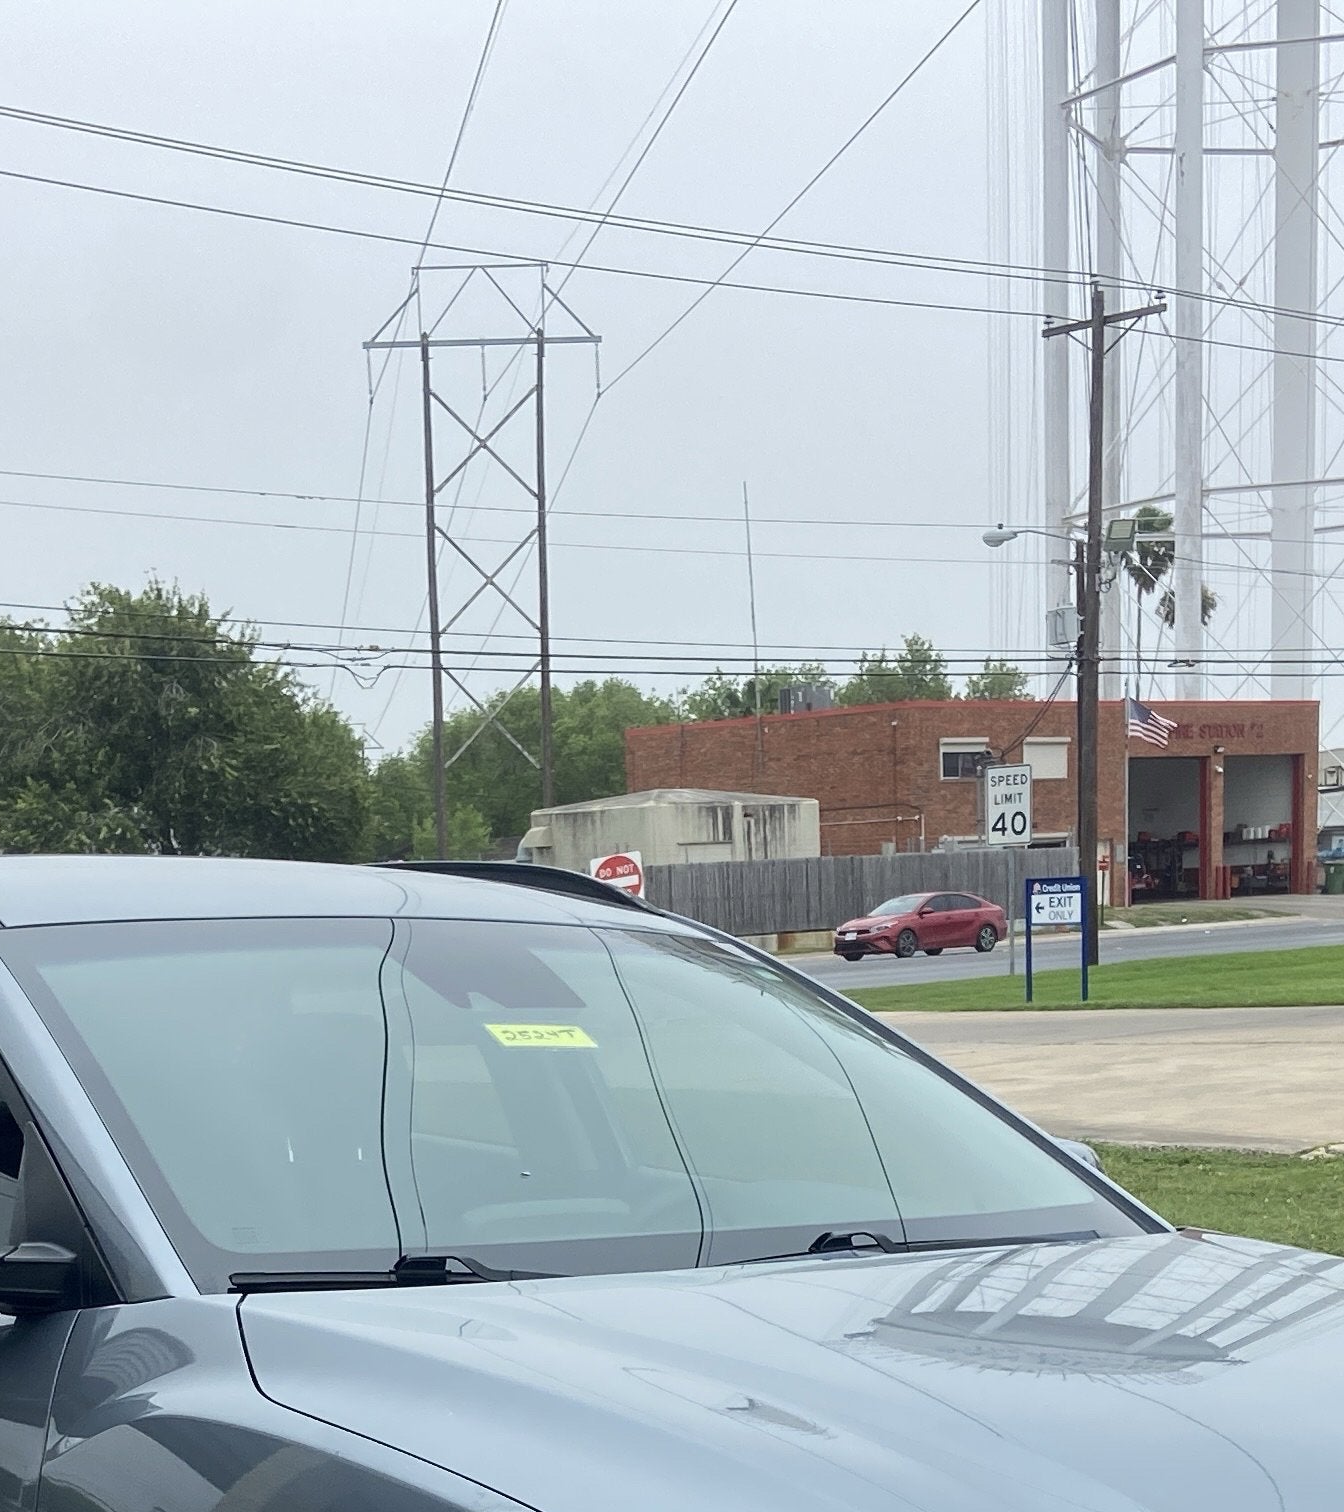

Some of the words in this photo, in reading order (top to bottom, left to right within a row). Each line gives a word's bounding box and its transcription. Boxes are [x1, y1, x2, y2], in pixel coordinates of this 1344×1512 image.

[990, 773, 1028, 788] SPEED
[994, 792, 1023, 806] LIMIT
[991, 811, 1027, 837] 40
[598, 867, 613, 879] DO
[616, 863, 635, 876] NOT
[1042, 883, 1062, 893] Credit
[1062, 882, 1081, 893] Union
[1048, 895, 1074, 908] EXIT
[1048, 910, 1074, 921] ONLY
